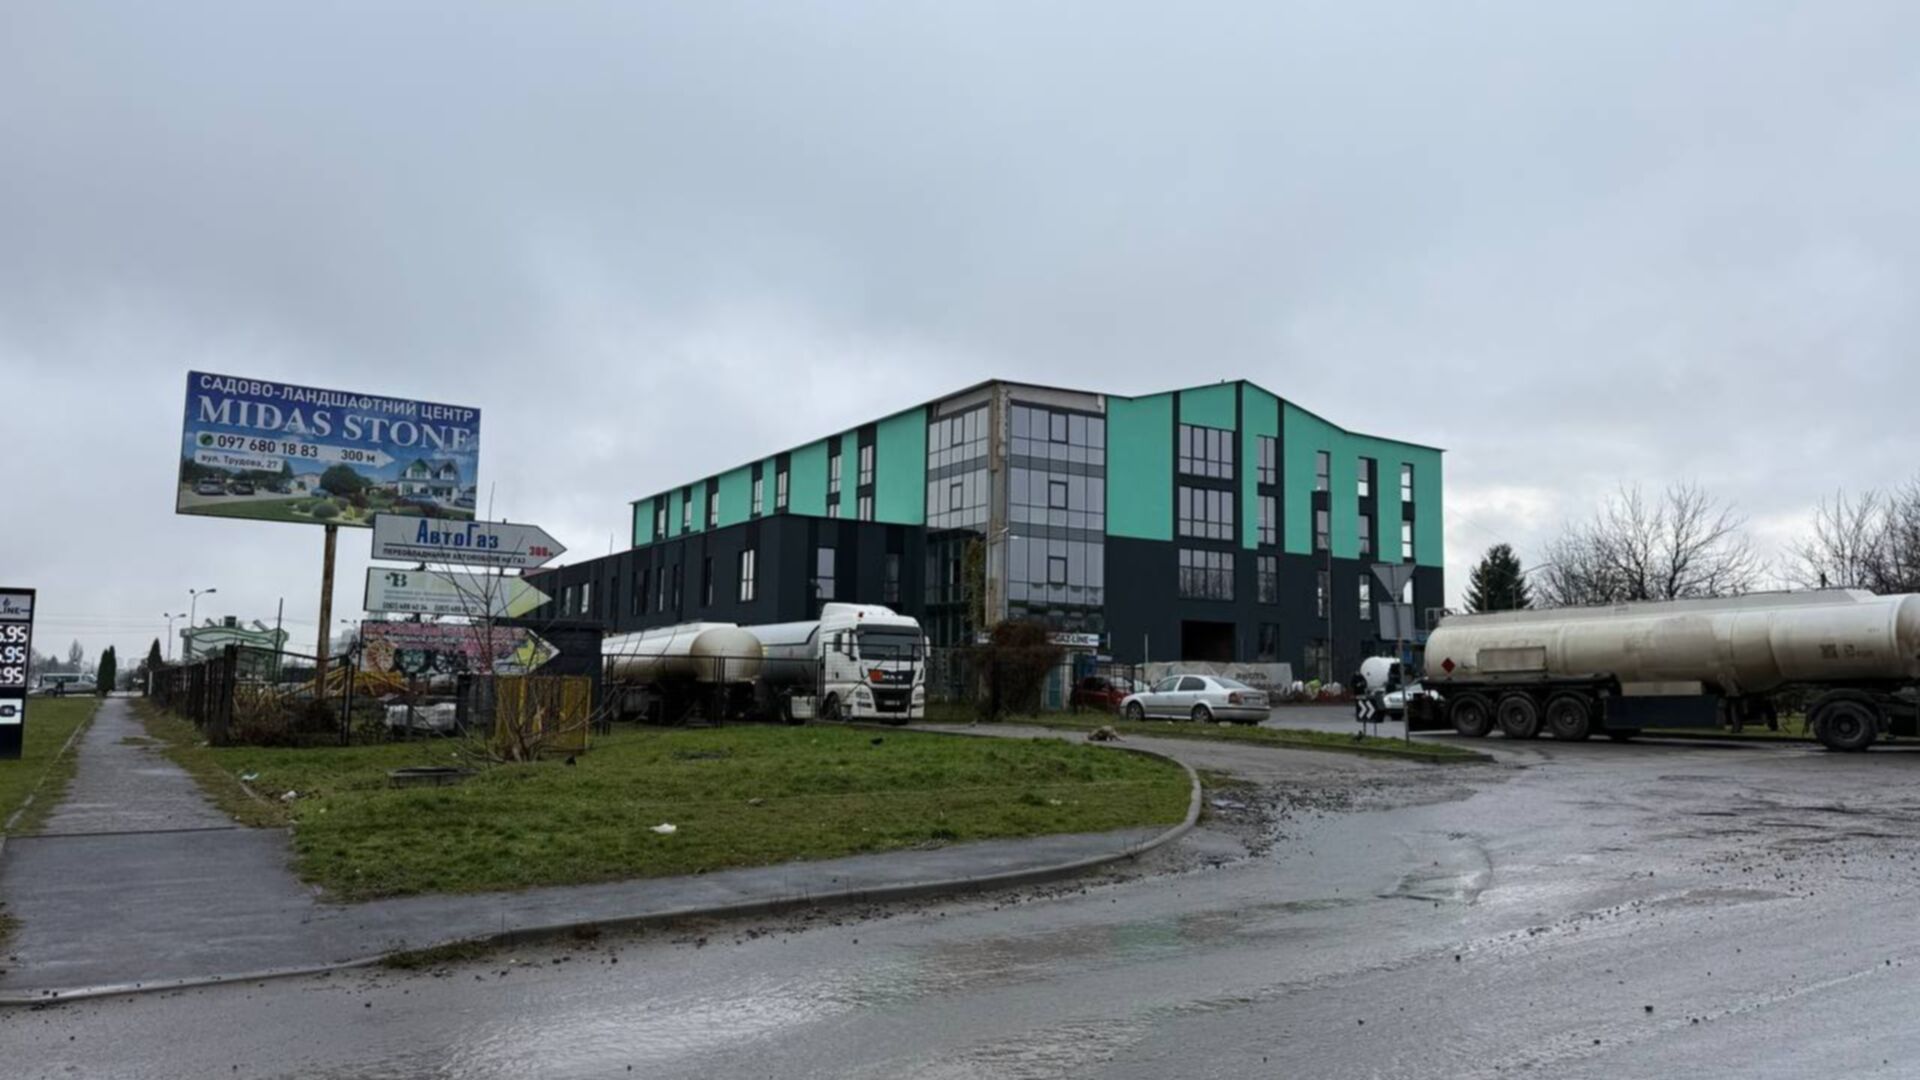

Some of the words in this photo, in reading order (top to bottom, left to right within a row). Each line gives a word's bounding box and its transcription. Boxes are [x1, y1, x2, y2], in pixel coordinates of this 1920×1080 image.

[201, 375, 417, 416] САДОВО-ЛАНДШАФТНИЙ
[421, 405, 473, 422] ЦЕНТР
[198, 395, 331, 437] MIDAS
[343, 415, 470, 451] STONE
[218, 435, 245, 449] 097
[249, 439, 276, 453] 680
[282, 442, 296, 456] 18
[301, 445, 318, 457] 83
[341, 449, 363, 461] 300
[416, 519, 499, 549] АвтоГаз
[0, 646, 25, 663] .95
